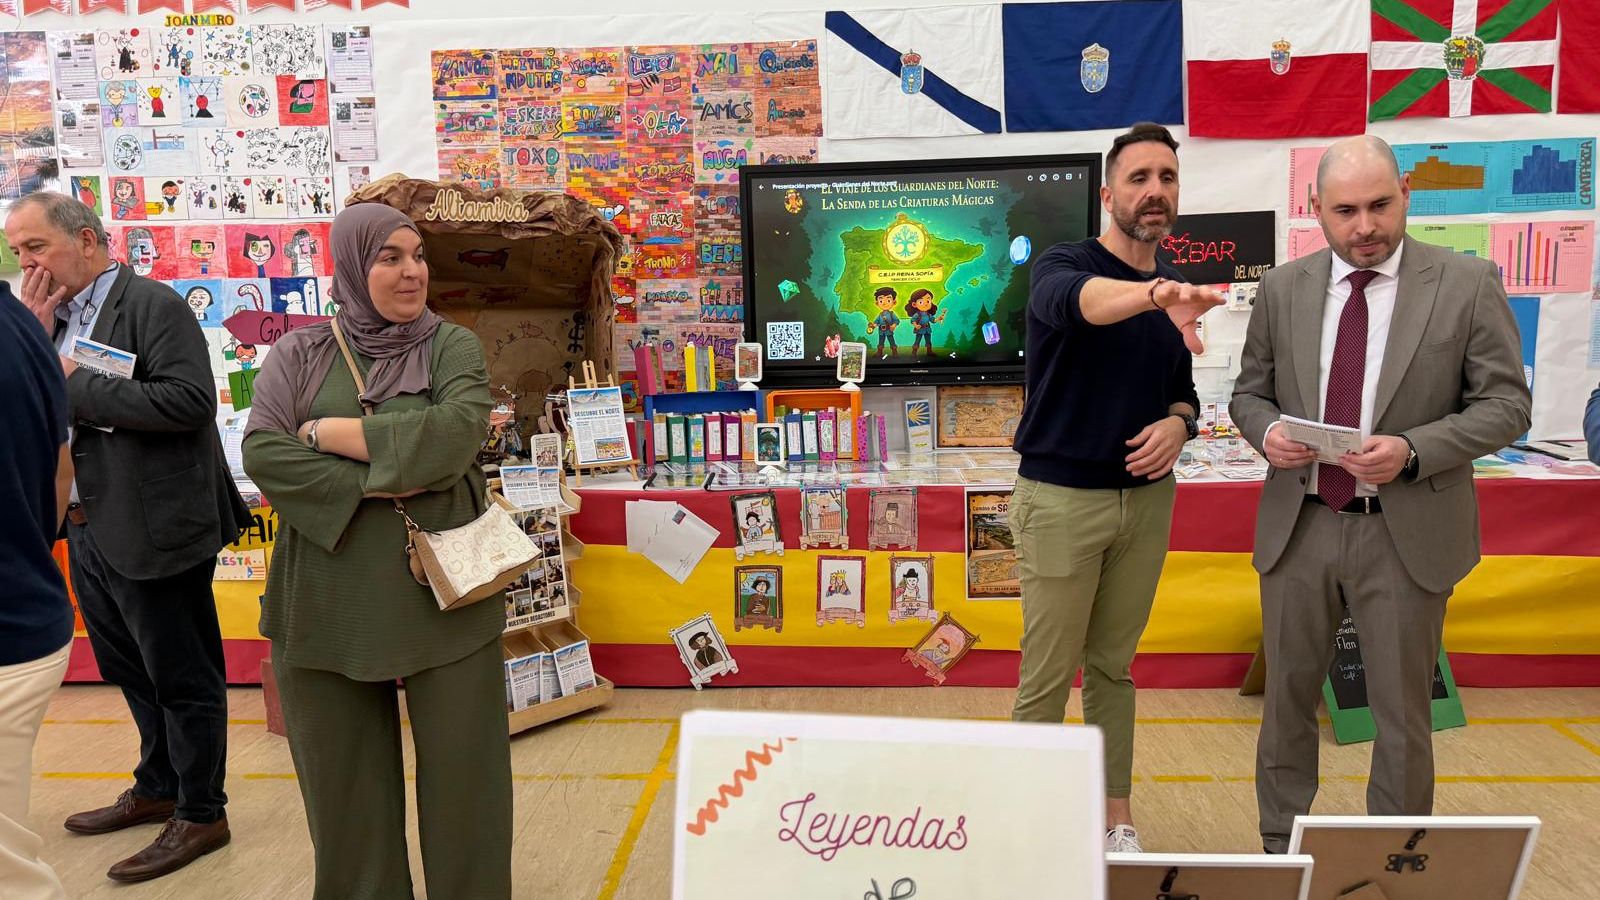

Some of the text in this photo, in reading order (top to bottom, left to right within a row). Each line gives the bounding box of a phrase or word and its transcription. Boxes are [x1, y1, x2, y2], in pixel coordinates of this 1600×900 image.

[165, 14, 234, 26] JOAN MIRO
[504, 147, 560, 167] TOXO
[703, 149, 747, 170] AUGA
[861, 185, 871, 193] DE
[873, 184, 888, 193] LOS
[948, 181, 964, 190] DEL
[966, 178, 999, 189] NORTE:
[426, 188, 529, 222] Altamira
[822, 194, 994, 210] LA SENDA DE LAS CRIATURAS MÁGICAS
[1189, 242, 1235, 262] BAR
[1235, 265, 1247, 279] DEL
[778, 792, 968, 862] Leyendas
